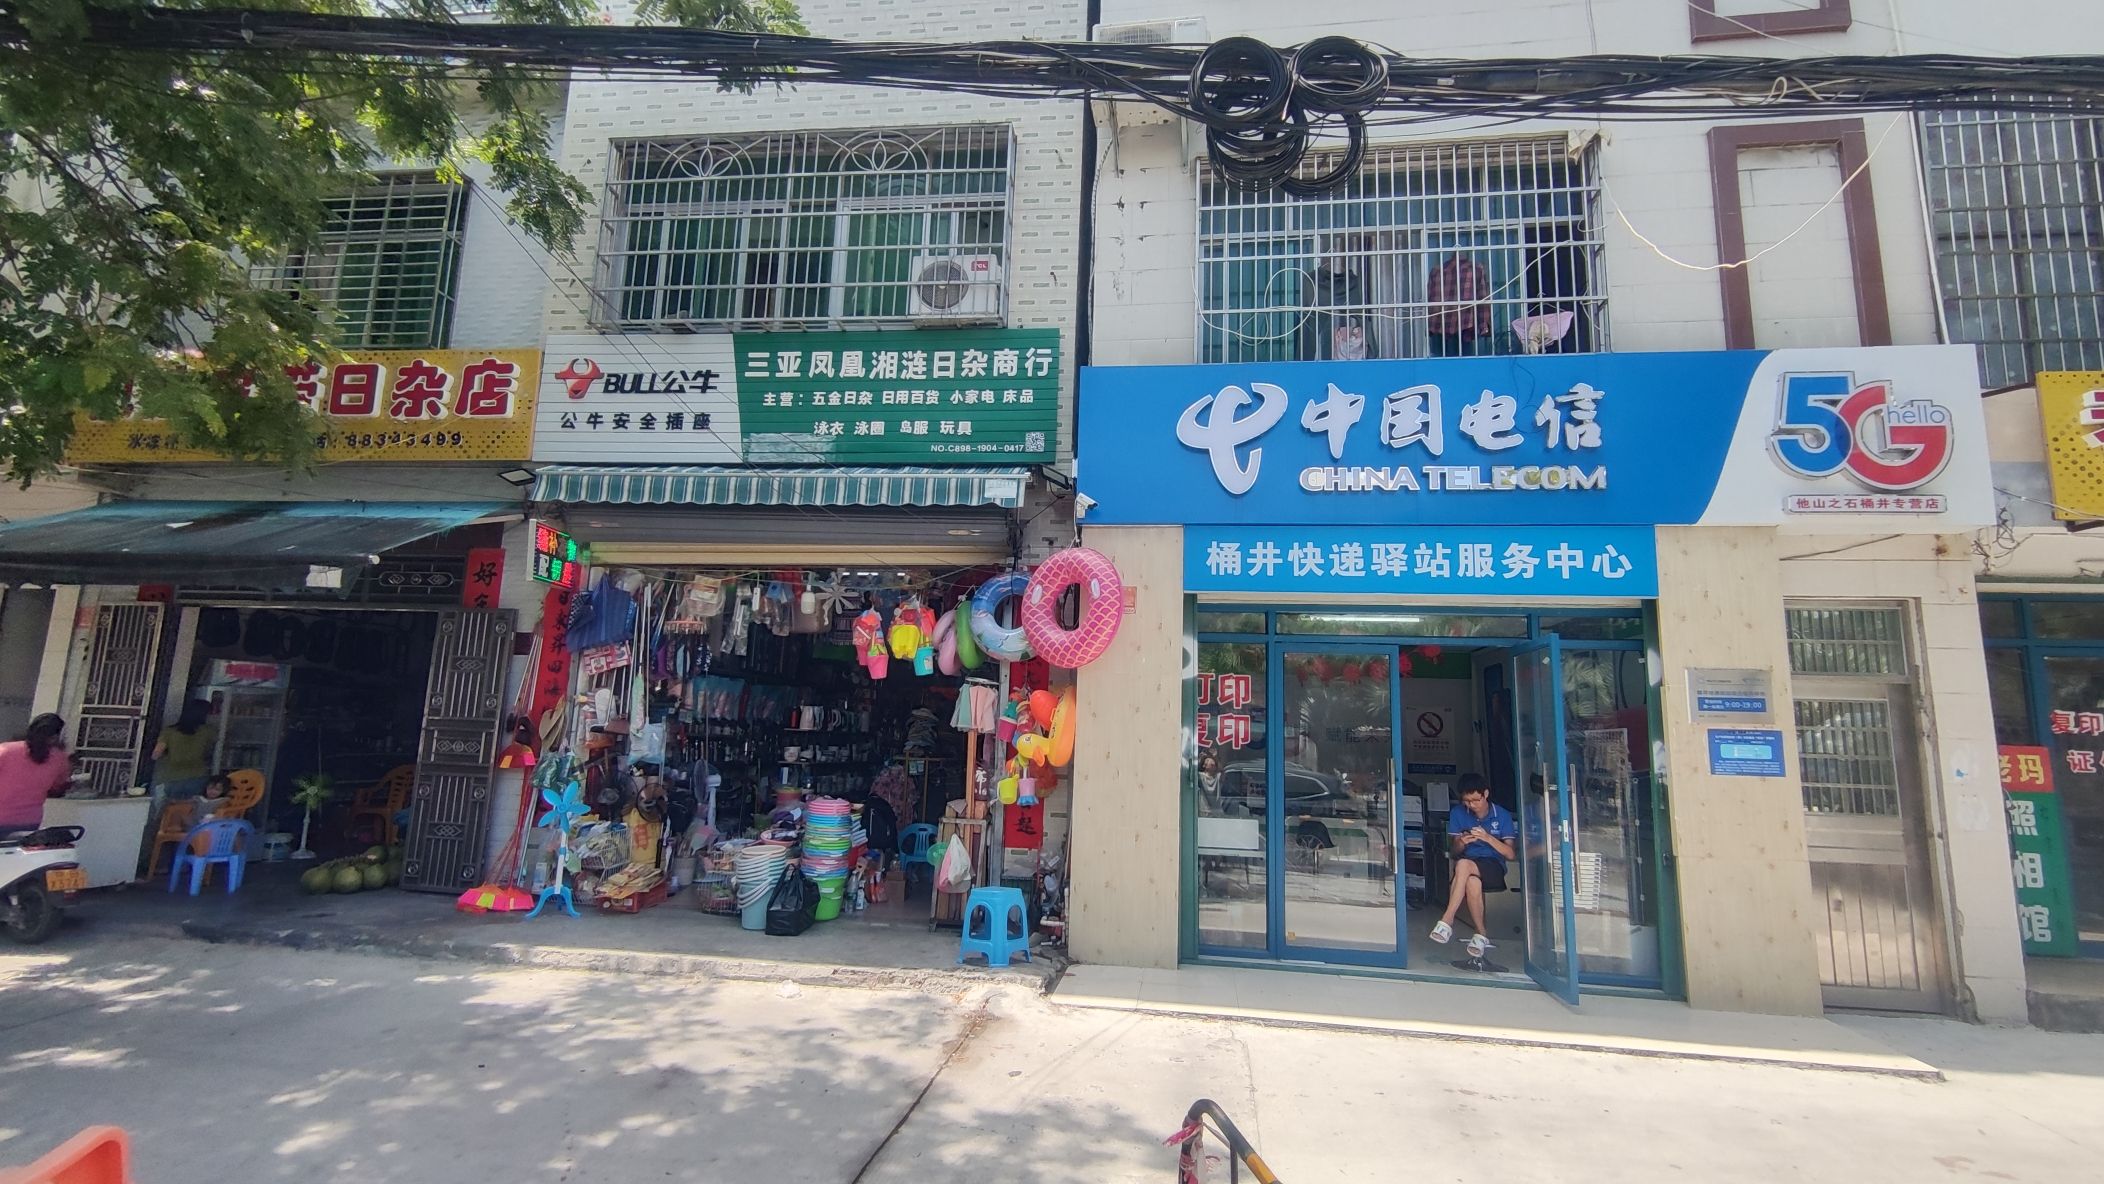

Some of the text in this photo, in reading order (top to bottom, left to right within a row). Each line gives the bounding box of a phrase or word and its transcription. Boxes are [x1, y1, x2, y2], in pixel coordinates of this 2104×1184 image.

[744, 348, 1053, 380] 三亚凤凰湘涟日杂商行
[882, 390, 940, 405] 日用百货
[950, 389, 996, 405] 小家电
[1002, 389, 1034, 404] 床品
[560, 411, 712, 431] 公牛安全插座
[1300, 381, 1606, 460] 中国电信
[1886, 404, 1946, 425] hello
[814, 420, 973, 437] 泳衣 泳圈 岛服 玩具
[1771, 371, 1954, 489] 5G
[1299, 464, 1608, 492] CHINA TELECOM
[1795, 498, 1940, 509] 他山之石桶井专营店
[1205, 540, 1634, 580] 桶井快递驿站服务中心
